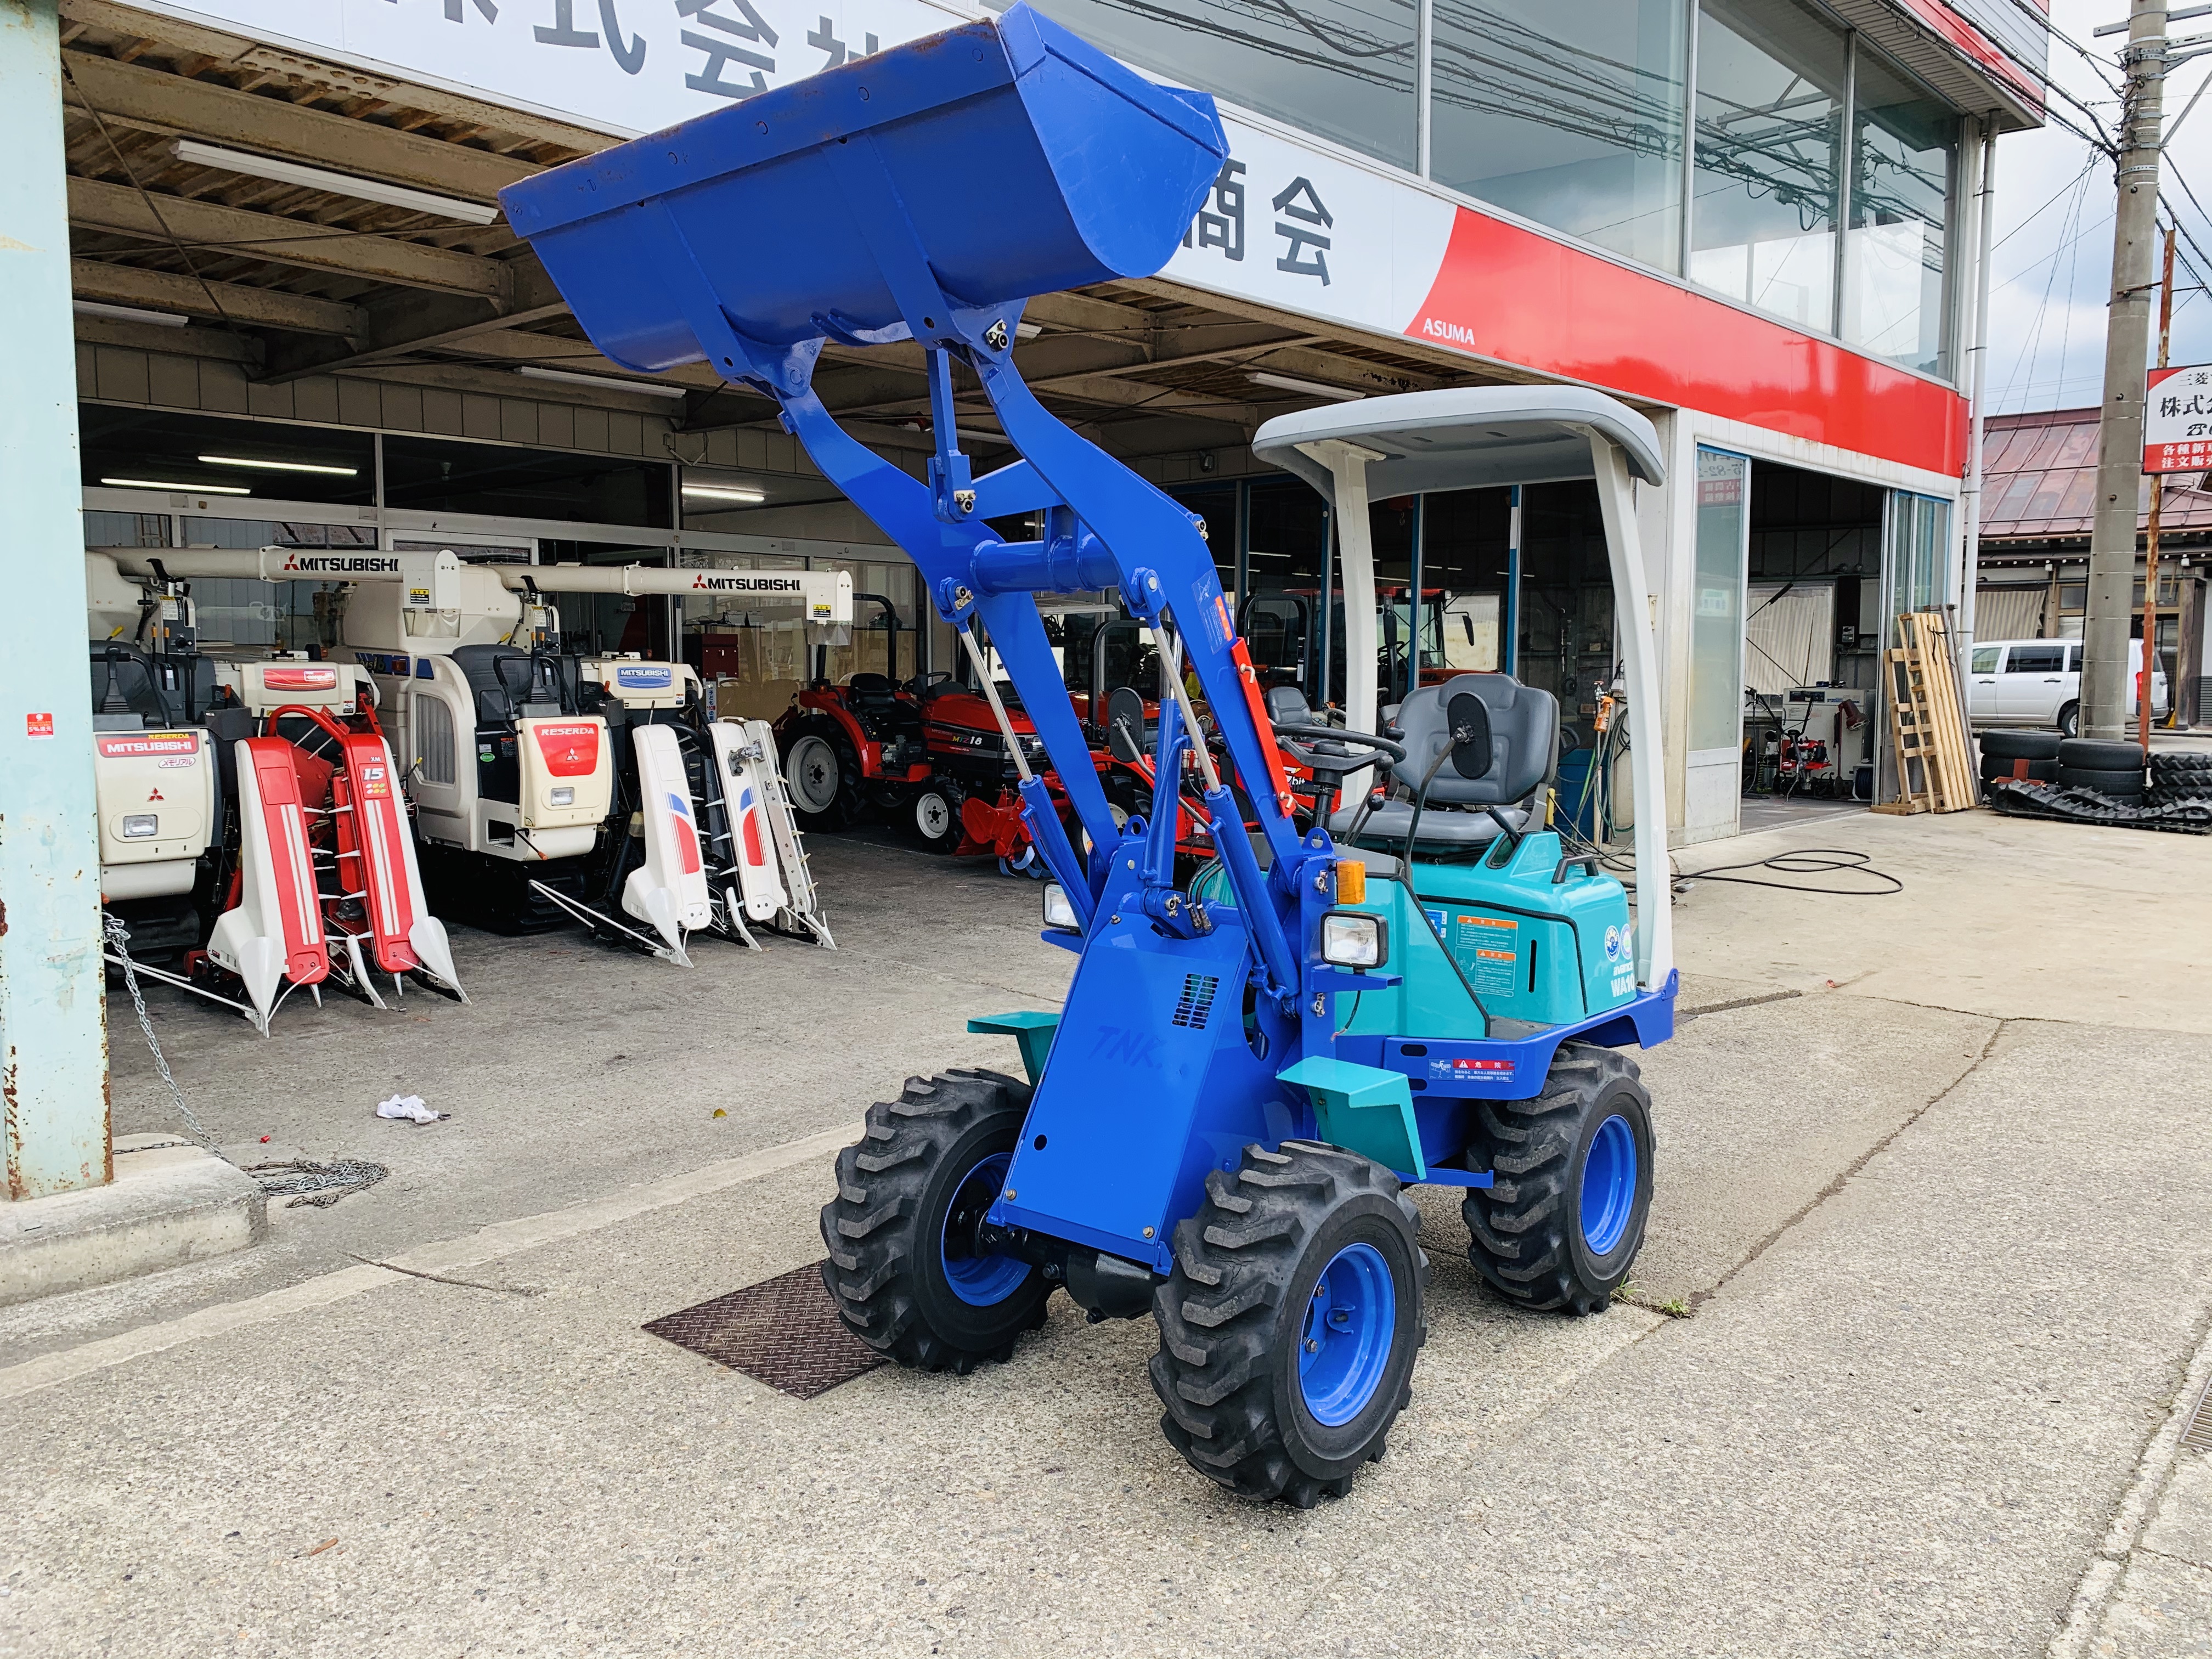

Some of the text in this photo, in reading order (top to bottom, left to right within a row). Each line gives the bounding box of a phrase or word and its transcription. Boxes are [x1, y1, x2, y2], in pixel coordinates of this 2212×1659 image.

[379, 0, 879, 99] 式会
[1423, 317, 1475, 346] ASUMA
[2178, 371, 2212, 387] 三菱
[2159, 394, 2212, 418] 株式
[300, 557, 399, 572] MITSUBISHI
[707, 578, 800, 591] MITSUBISHI
[620, 669, 669, 678] MITSUBISHI
[540, 727, 595, 736] RESERDA
[106, 741, 193, 753] MITSUBISHI
[161, 758, 193, 767] メモリアル
[363, 768, 385, 782] 15
[1610, 973, 1635, 997] WA10
[1475, 1061, 1502, 1069] 危険
